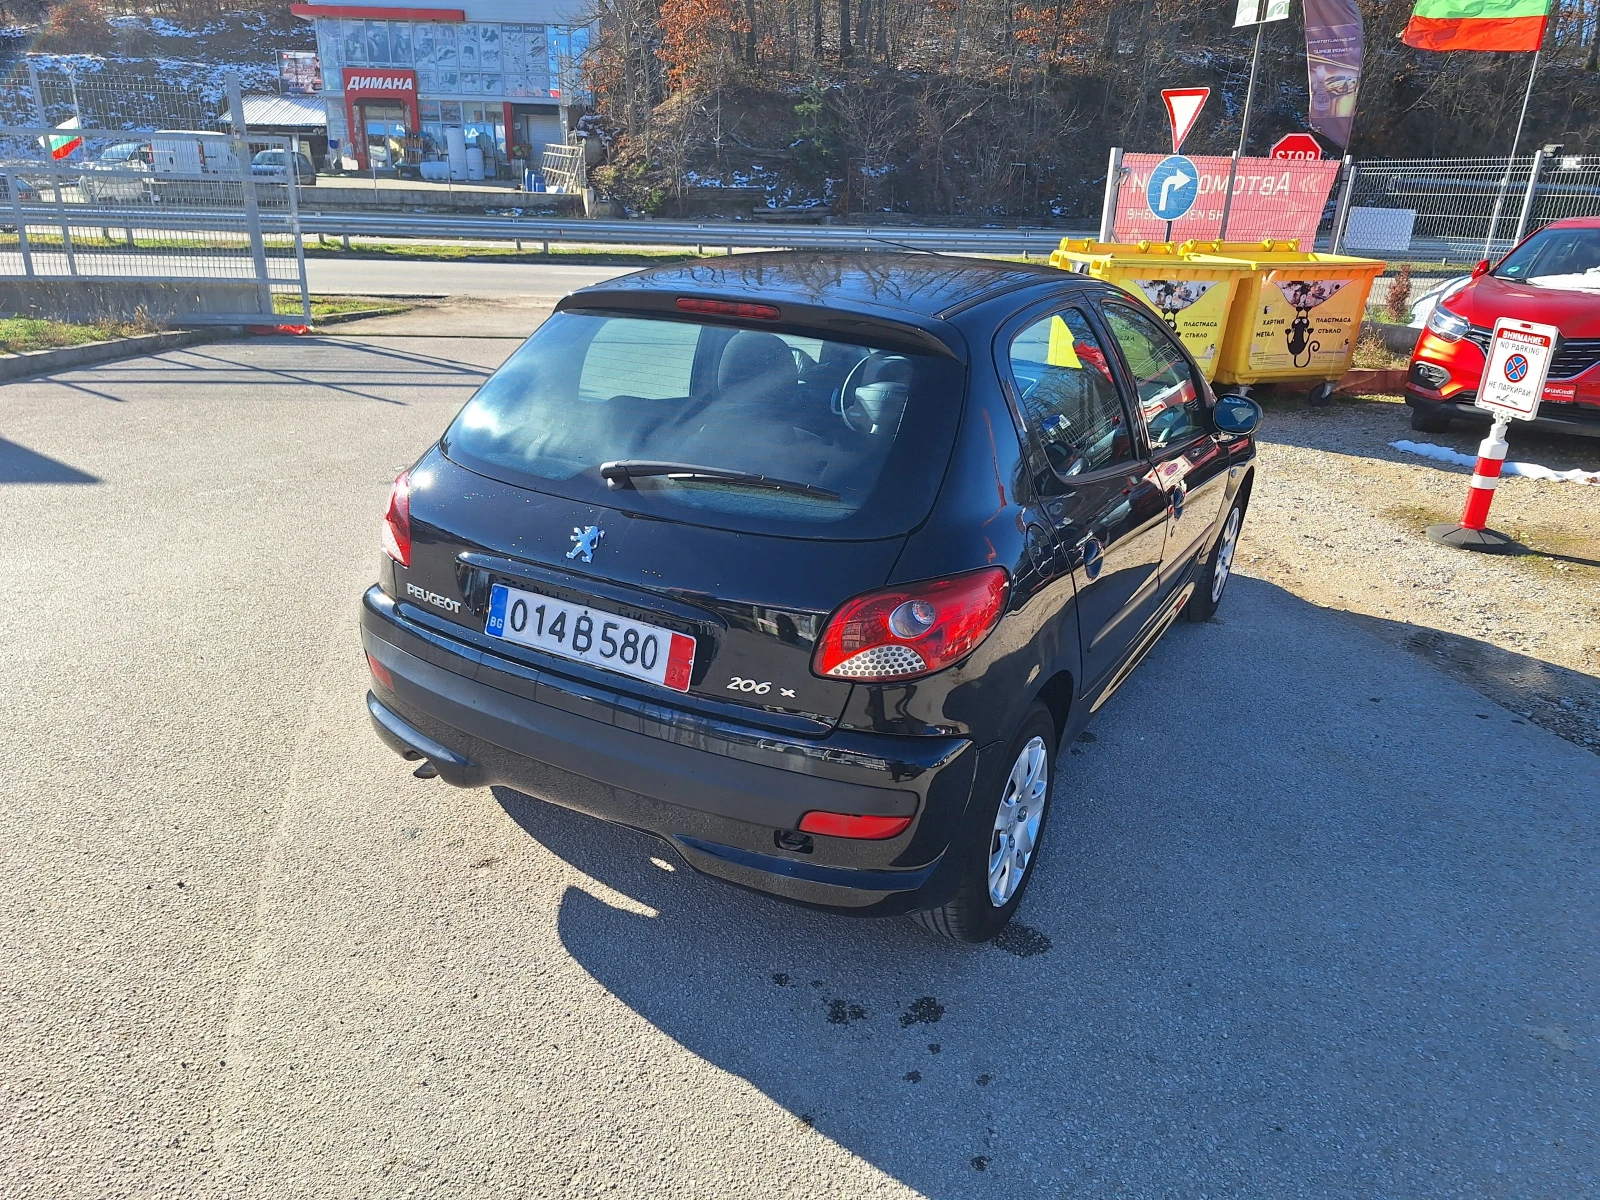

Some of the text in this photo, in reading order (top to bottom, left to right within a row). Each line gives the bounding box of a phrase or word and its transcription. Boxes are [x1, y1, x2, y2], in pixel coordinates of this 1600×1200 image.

[347, 76, 413, 90] ДИМАНА
[1502, 330, 1546, 345] ВНИМАНИЕ!
[1500, 341, 1510, 350] NO
[1488, 380, 1497, 389] НЕ
[406, 582, 462, 614] PEUGEOT
[489, 616, 504, 629] BG
[726, 676, 773, 695] 206
